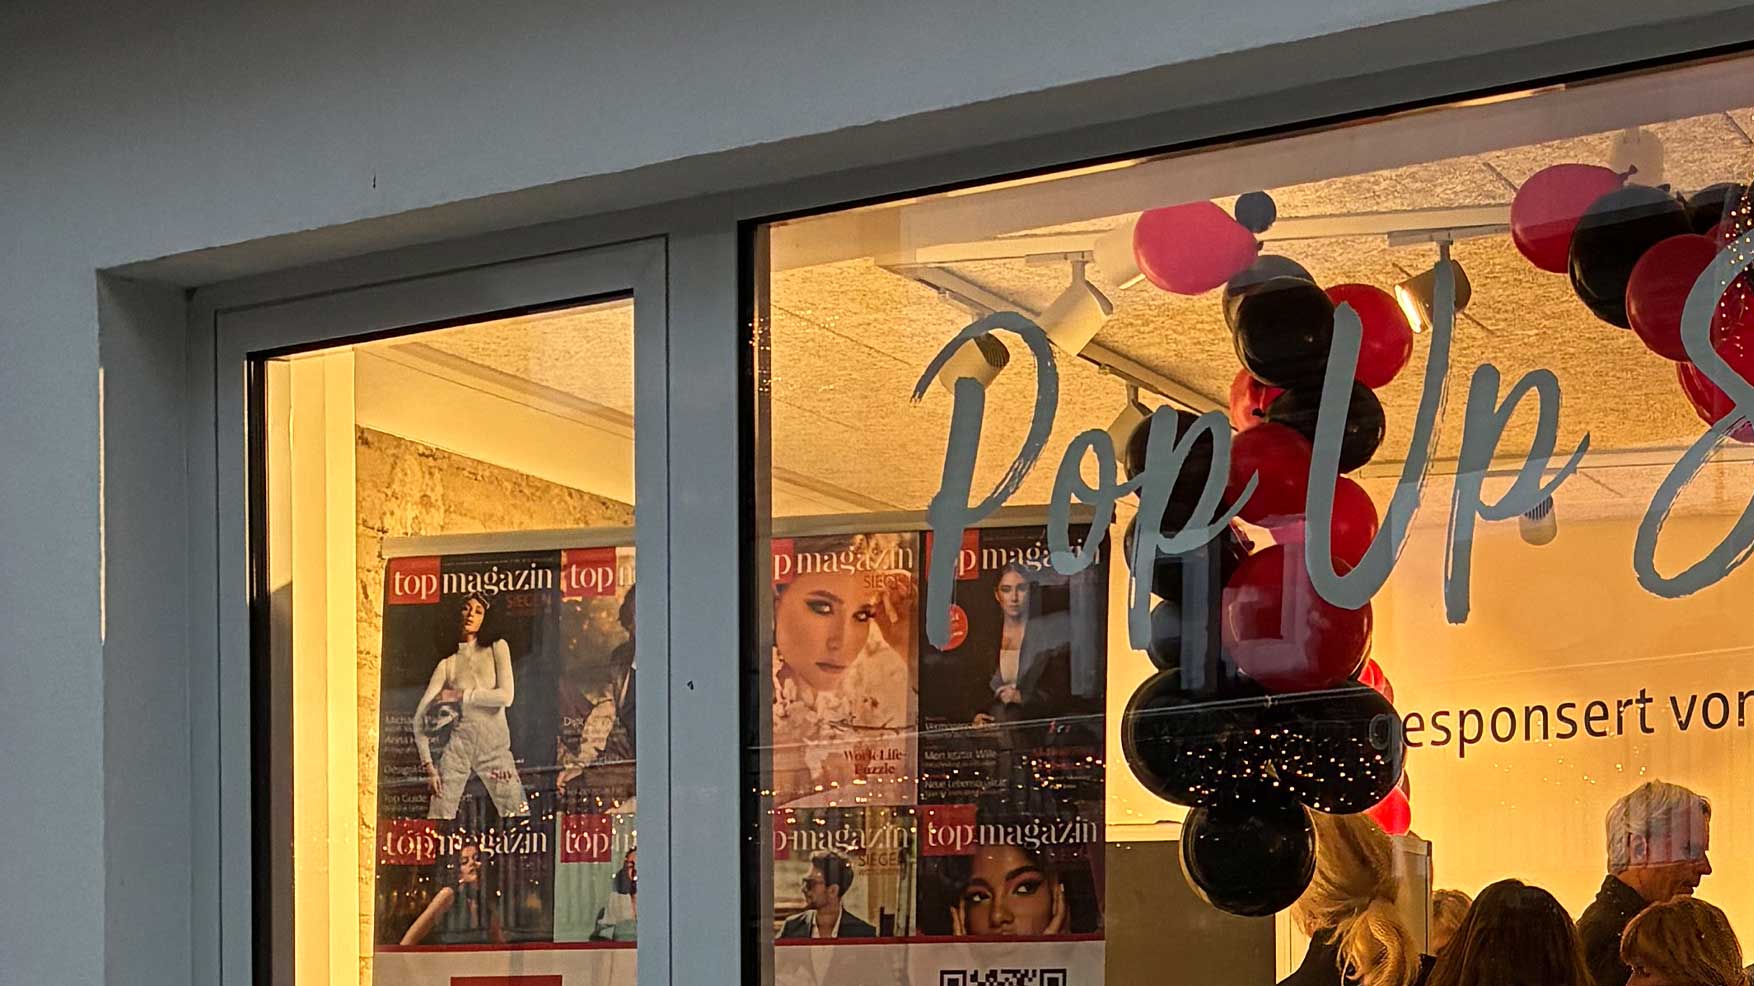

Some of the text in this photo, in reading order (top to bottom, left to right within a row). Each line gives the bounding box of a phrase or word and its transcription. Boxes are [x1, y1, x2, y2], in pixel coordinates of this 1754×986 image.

[911, 310, 1258, 651] Pop
[1304, 262, 1590, 624] Up
[797, 537, 913, 577] magazin
[394, 562, 552, 600] top magazin
[571, 563, 614, 593] top
[385, 829, 434, 861] top
[565, 829, 609, 859] top
[799, 822, 909, 853] magazin
[927, 815, 1098, 852] top magazin
